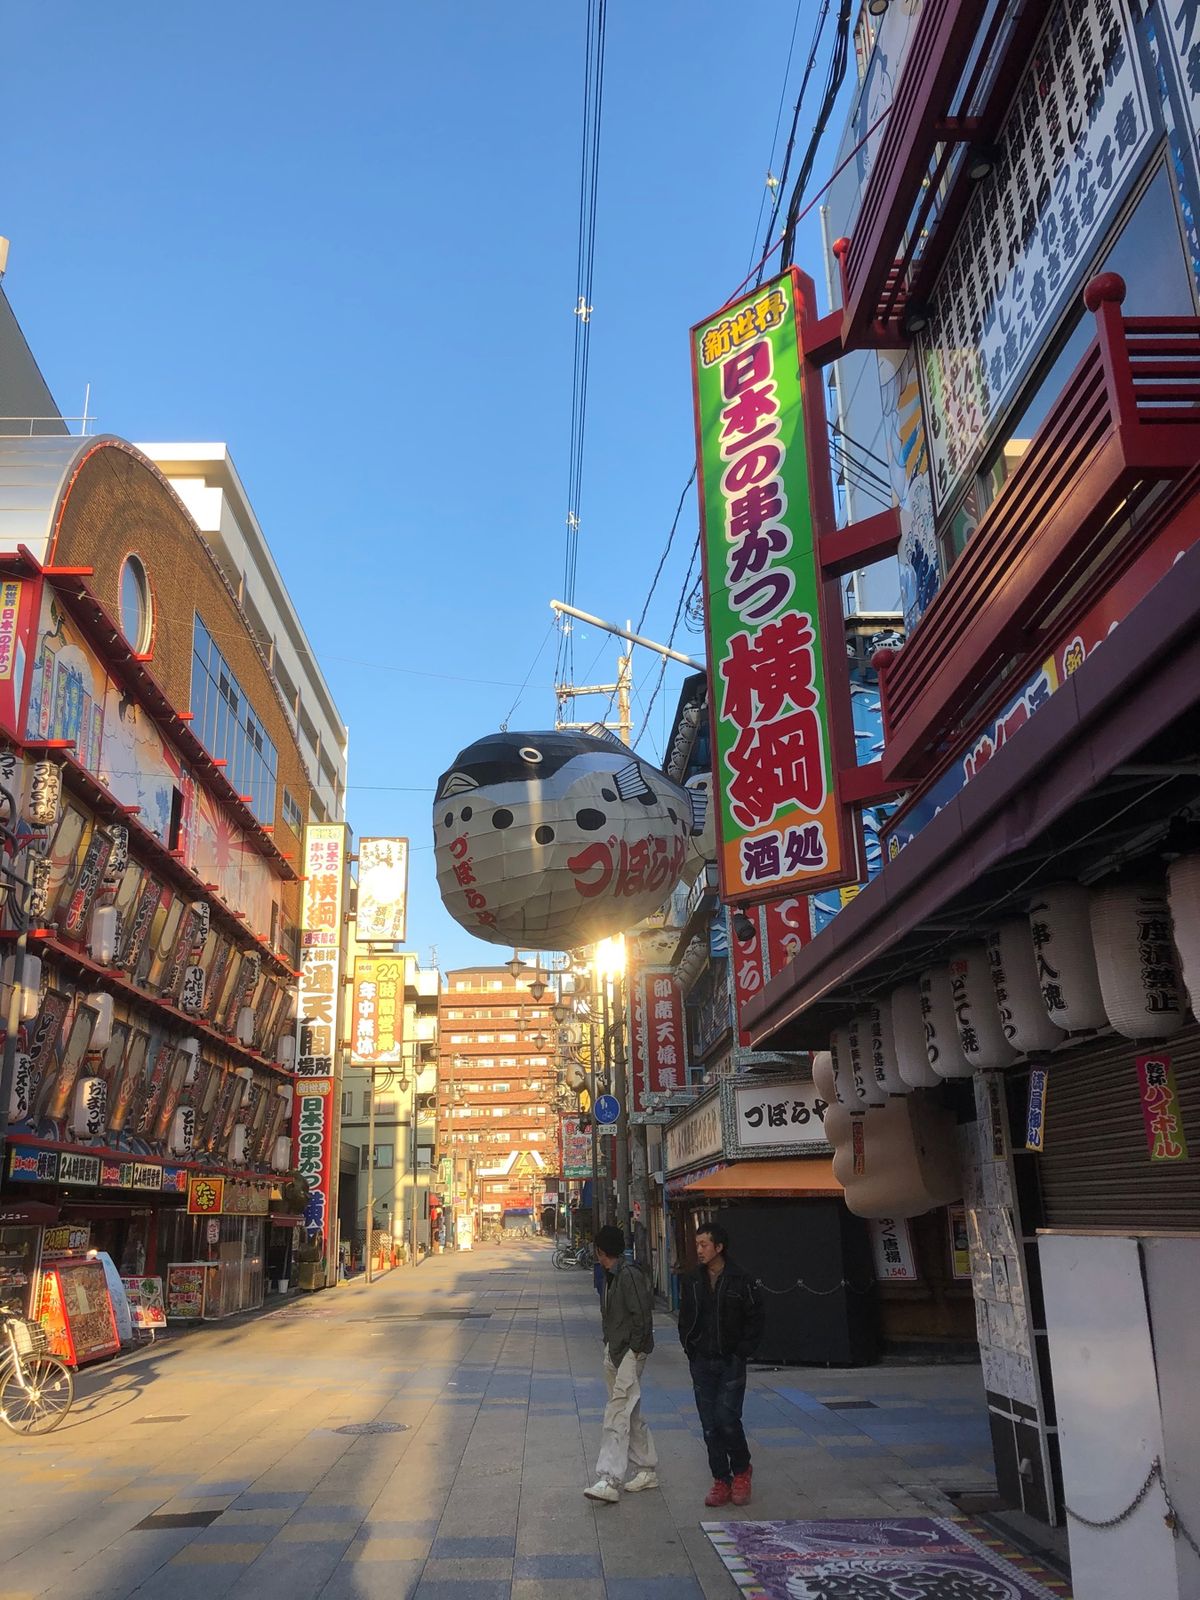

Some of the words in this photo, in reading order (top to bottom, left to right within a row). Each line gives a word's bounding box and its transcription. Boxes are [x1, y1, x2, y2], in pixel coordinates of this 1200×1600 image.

[1102, 20, 1136, 159] 椎茸
[1052, 140, 1079, 258] さつま芋
[1067, 103, 1097, 226] じゃが芋
[1036, 173, 1060, 289] 白ねぎ
[702, 291, 788, 363] 新世界
[994, 273, 1018, 373] しし唐
[1007, 235, 1032, 349] れんこん
[5, 584, 17, 607] 新世界
[310, 842, 324, 871] 串かつ
[450, 832, 497, 930] づぼらや
[567, 835, 687, 897] づぼらや
[744, 825, 825, 882] 酒処
[303, 932, 336, 945] 通天閣店
[308, 874, 337, 931] 横綱
[302, 949, 337, 962] 大相撲
[1029, 903, 1067, 1011] 一串入魂
[299, 965, 335, 1057] 通天閣
[357, 981, 377, 1056] 年中無休
[376, 964, 400, 1052] 24時間営業
[297, 1058, 331, 1077] 場所
[1145, 1062, 1167, 1086] 乾杯
[299, 1097, 323, 1187] 日本一の串かつ
[1145, 1086, 1182, 1157] ハイボール
[60, 1156, 97, 1182] 24時間営業
[135, 1167, 161, 1187] 24時間営業
